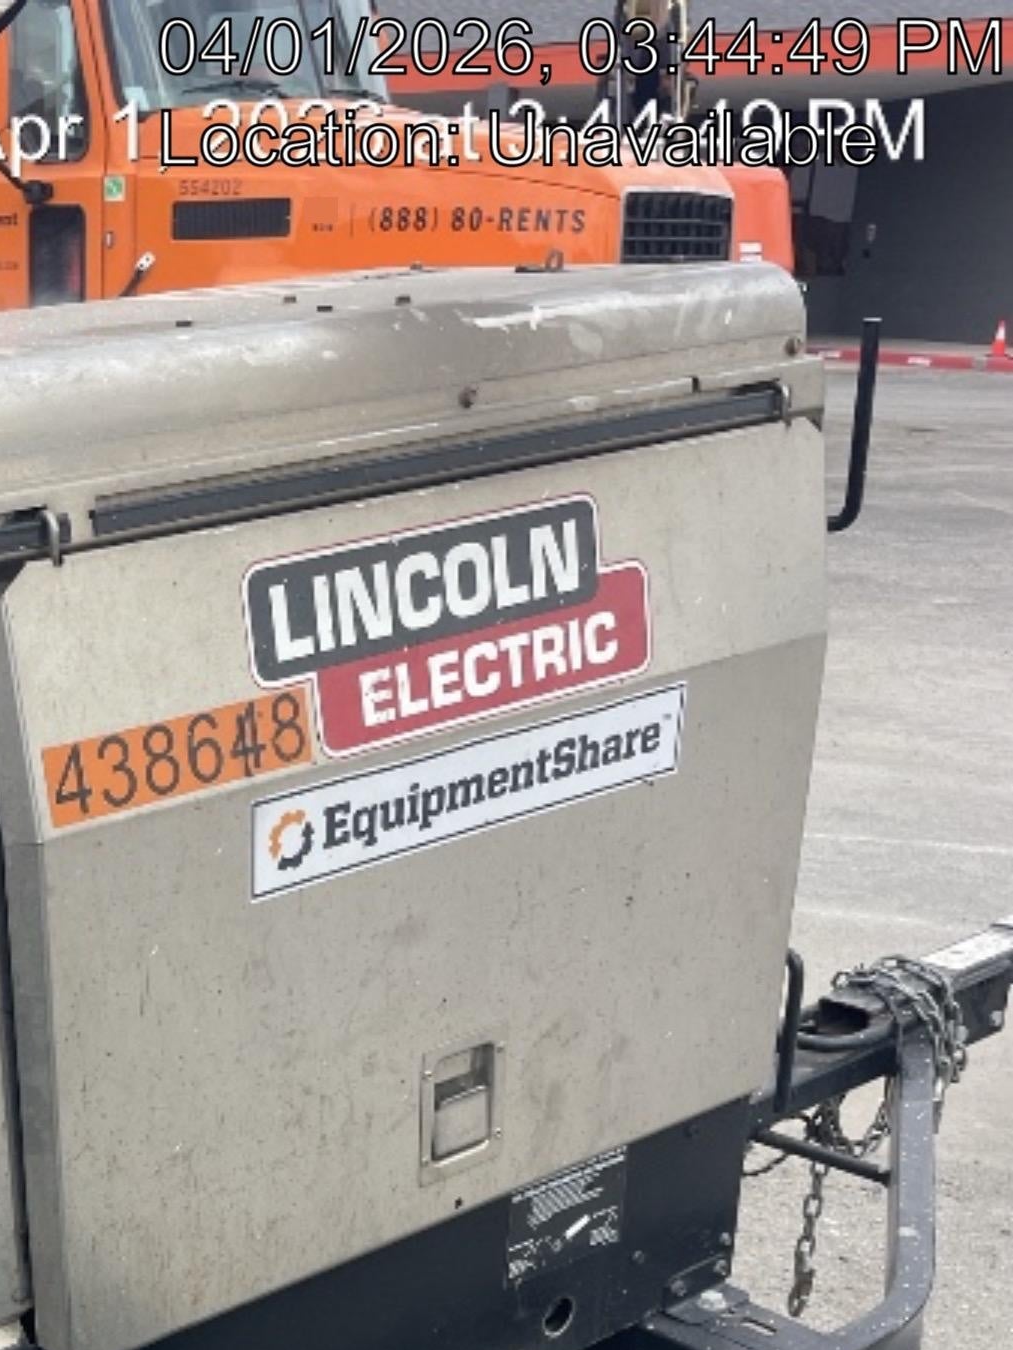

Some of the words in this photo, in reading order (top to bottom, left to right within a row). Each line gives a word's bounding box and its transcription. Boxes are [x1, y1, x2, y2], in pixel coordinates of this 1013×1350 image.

[367, 206, 439, 234] (888)
[450, 207, 587, 235] 80-RENTS
[268, 517, 581, 664] LINCOLN
[357, 610, 620, 728] ELECTRIC
[53, 690, 308, 815] 438648
[322, 717, 663, 852] EquipmentShare
